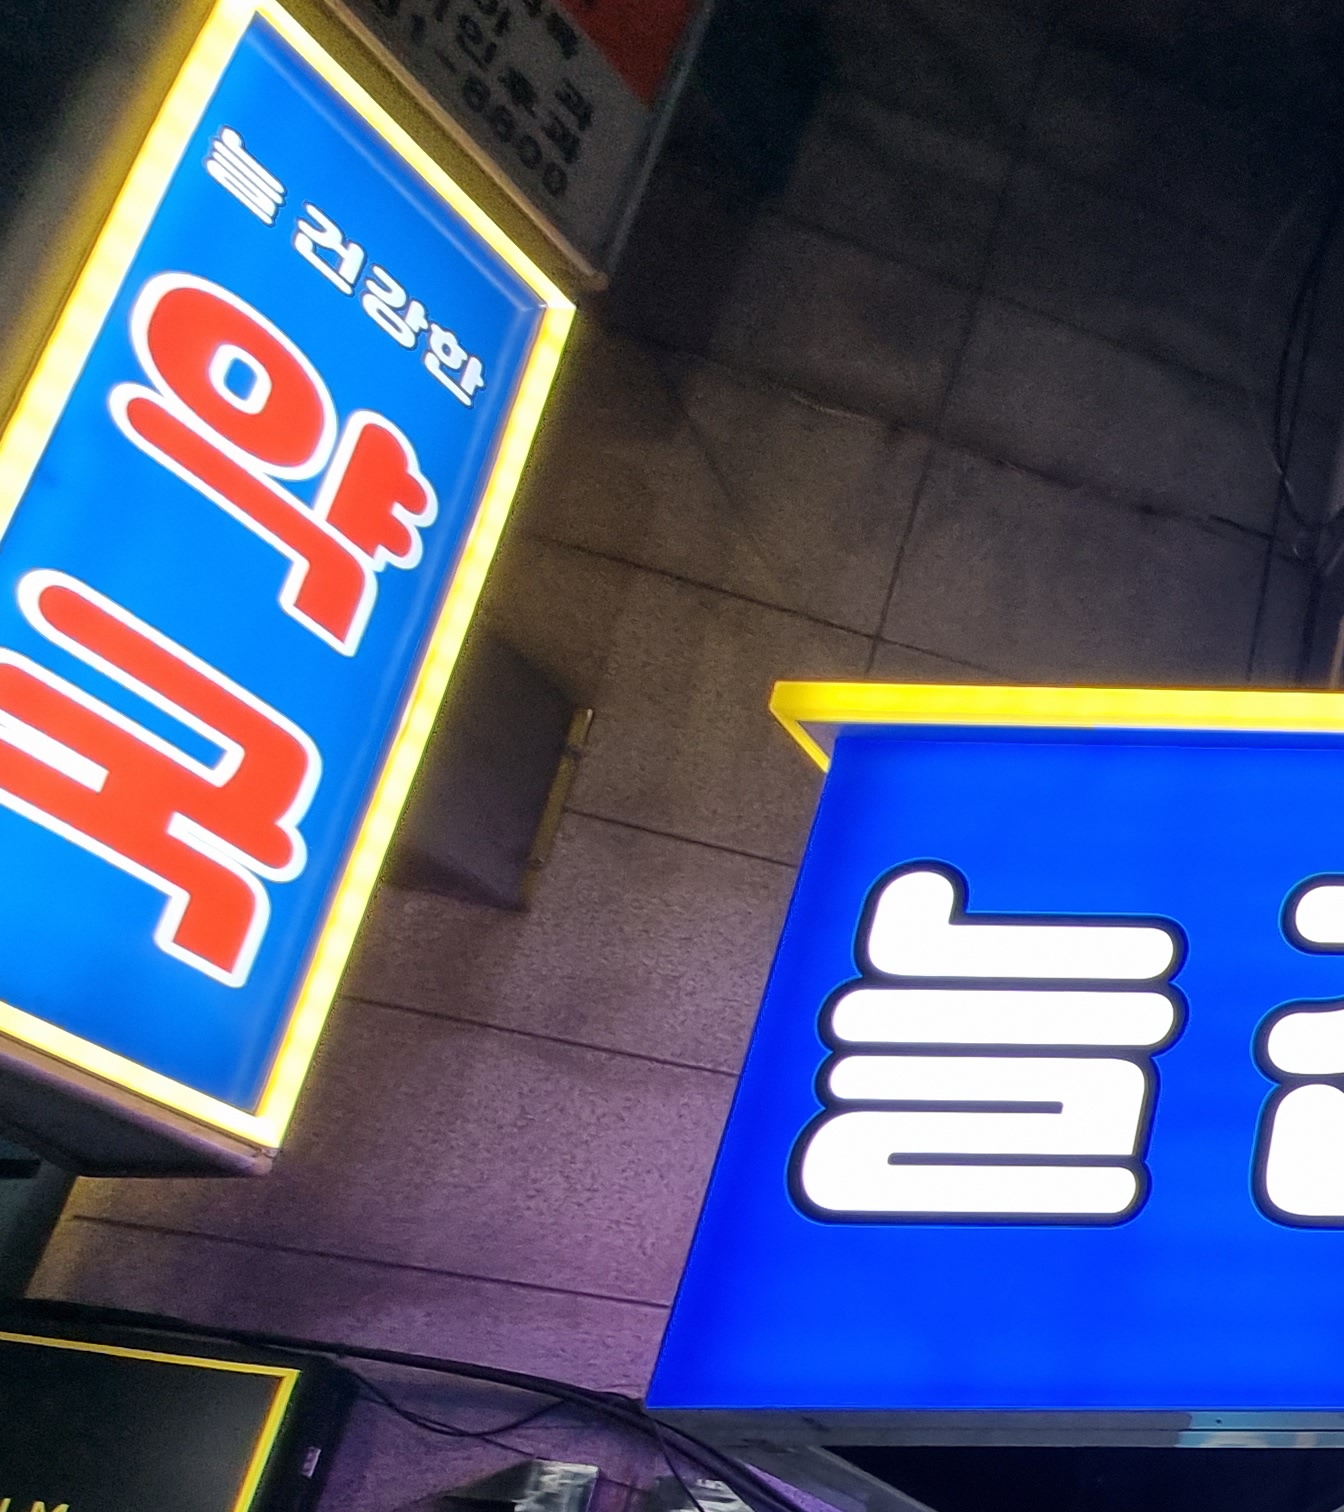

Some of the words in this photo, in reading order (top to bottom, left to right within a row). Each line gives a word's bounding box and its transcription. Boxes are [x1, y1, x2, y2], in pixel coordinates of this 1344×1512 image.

[205, 126, 286, 226] 늘
[293, 201, 486, 408] 건강한
[0, 272, 438, 988] 약국
[787, 858, 1189, 1228] 늘
